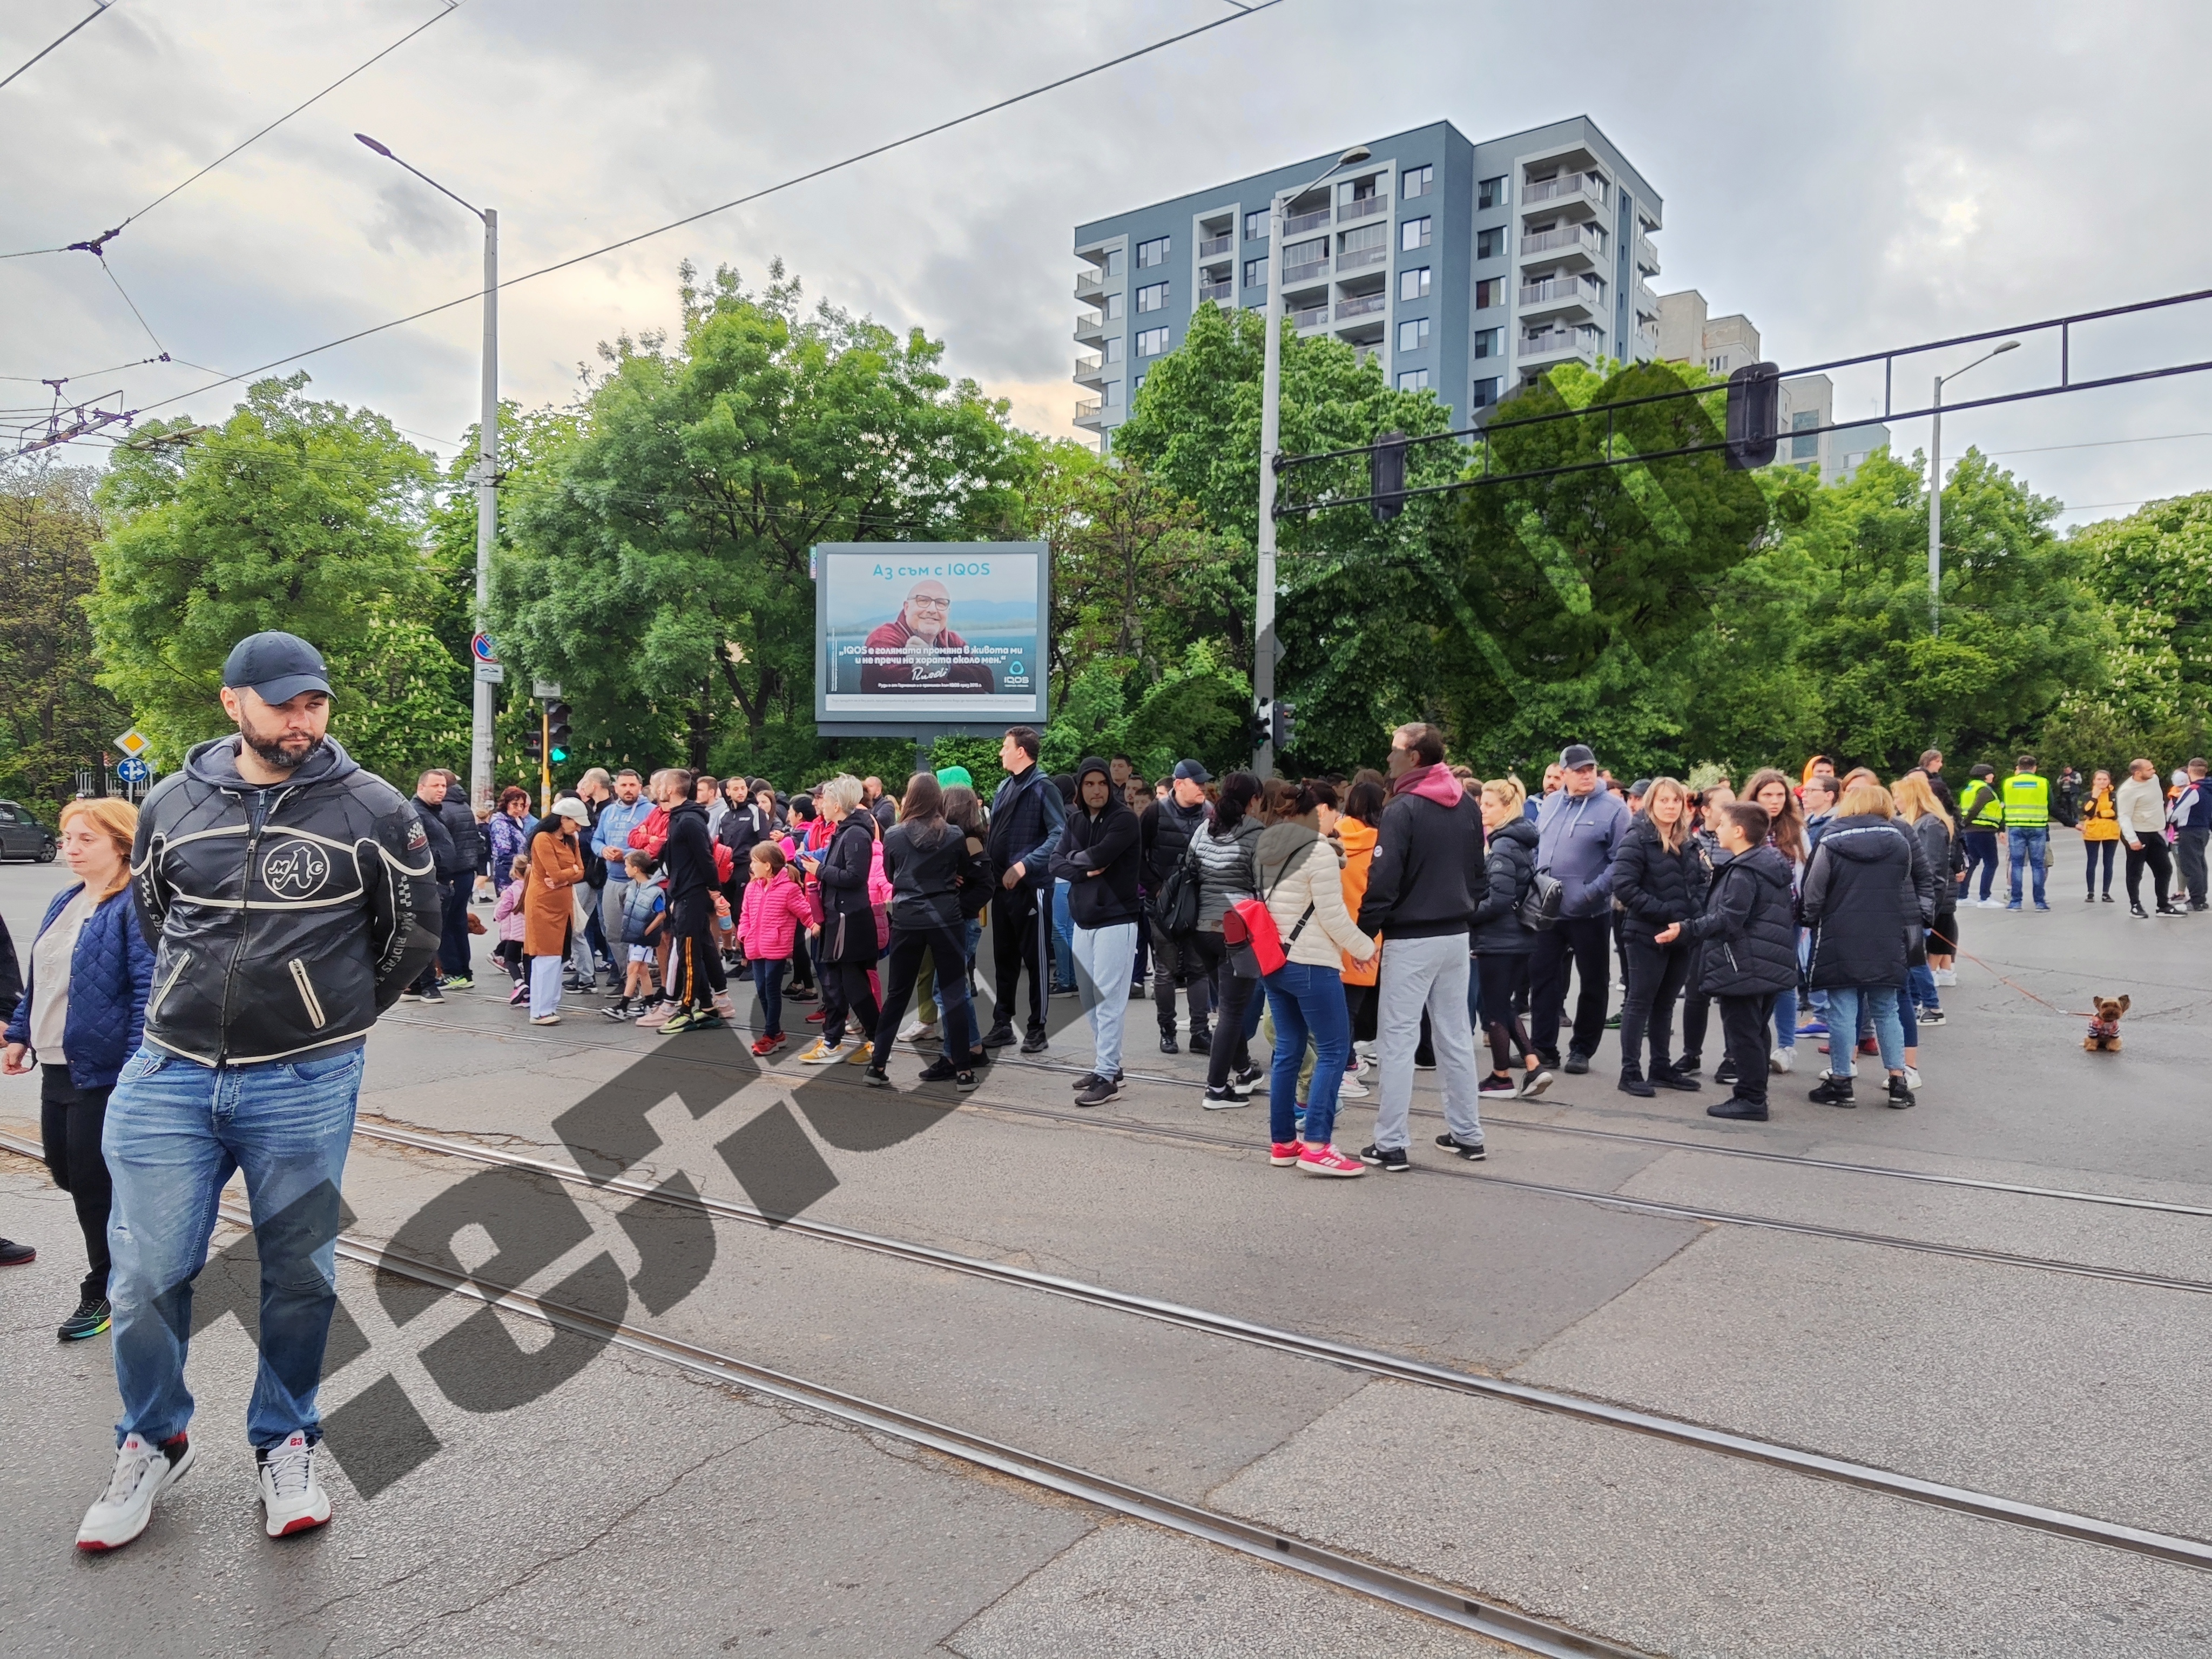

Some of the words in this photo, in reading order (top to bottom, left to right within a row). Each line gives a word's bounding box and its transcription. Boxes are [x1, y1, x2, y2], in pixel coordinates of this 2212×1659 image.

[873, 564, 893, 580] Аз
[898, 567, 929, 576] съм
[934, 567, 943, 576] с
[948, 563, 990, 576] IQOS
[923, 647, 962, 656] промяна
[963, 645, 969, 655] в
[970, 645, 1009, 655] живота
[874, 657, 901, 666] пречи
[915, 657, 952, 666] хората
[953, 655, 980, 664] около
[1004, 676, 1029, 684] IQOS
[290, 1437, 303, 1446] 23
